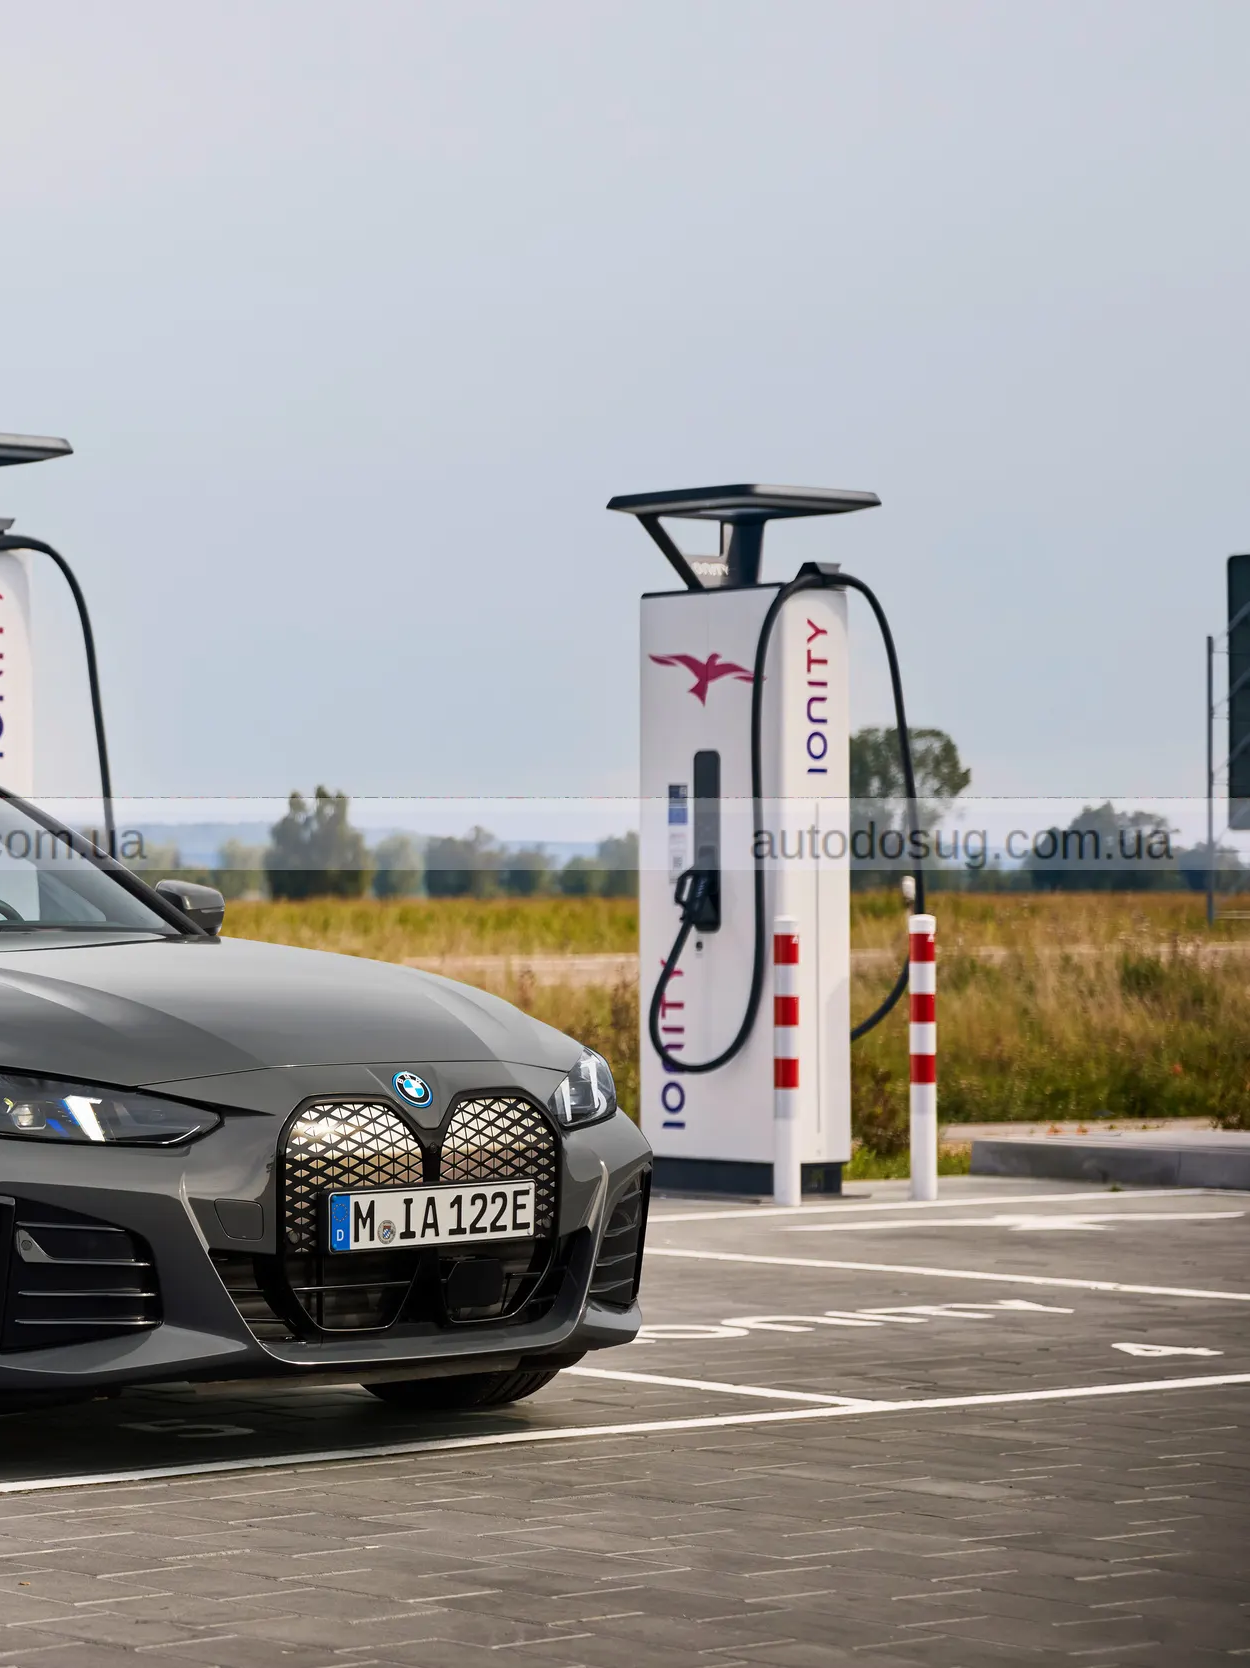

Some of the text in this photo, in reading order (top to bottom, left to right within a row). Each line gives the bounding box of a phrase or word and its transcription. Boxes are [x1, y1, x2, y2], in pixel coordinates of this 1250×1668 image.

[806, 618, 829, 774] IONITY
[336, 1229, 344, 1241] D
[353, 1199, 375, 1242] M
[399, 1196, 440, 1239] IA
[448, 1189, 531, 1236] 122E
